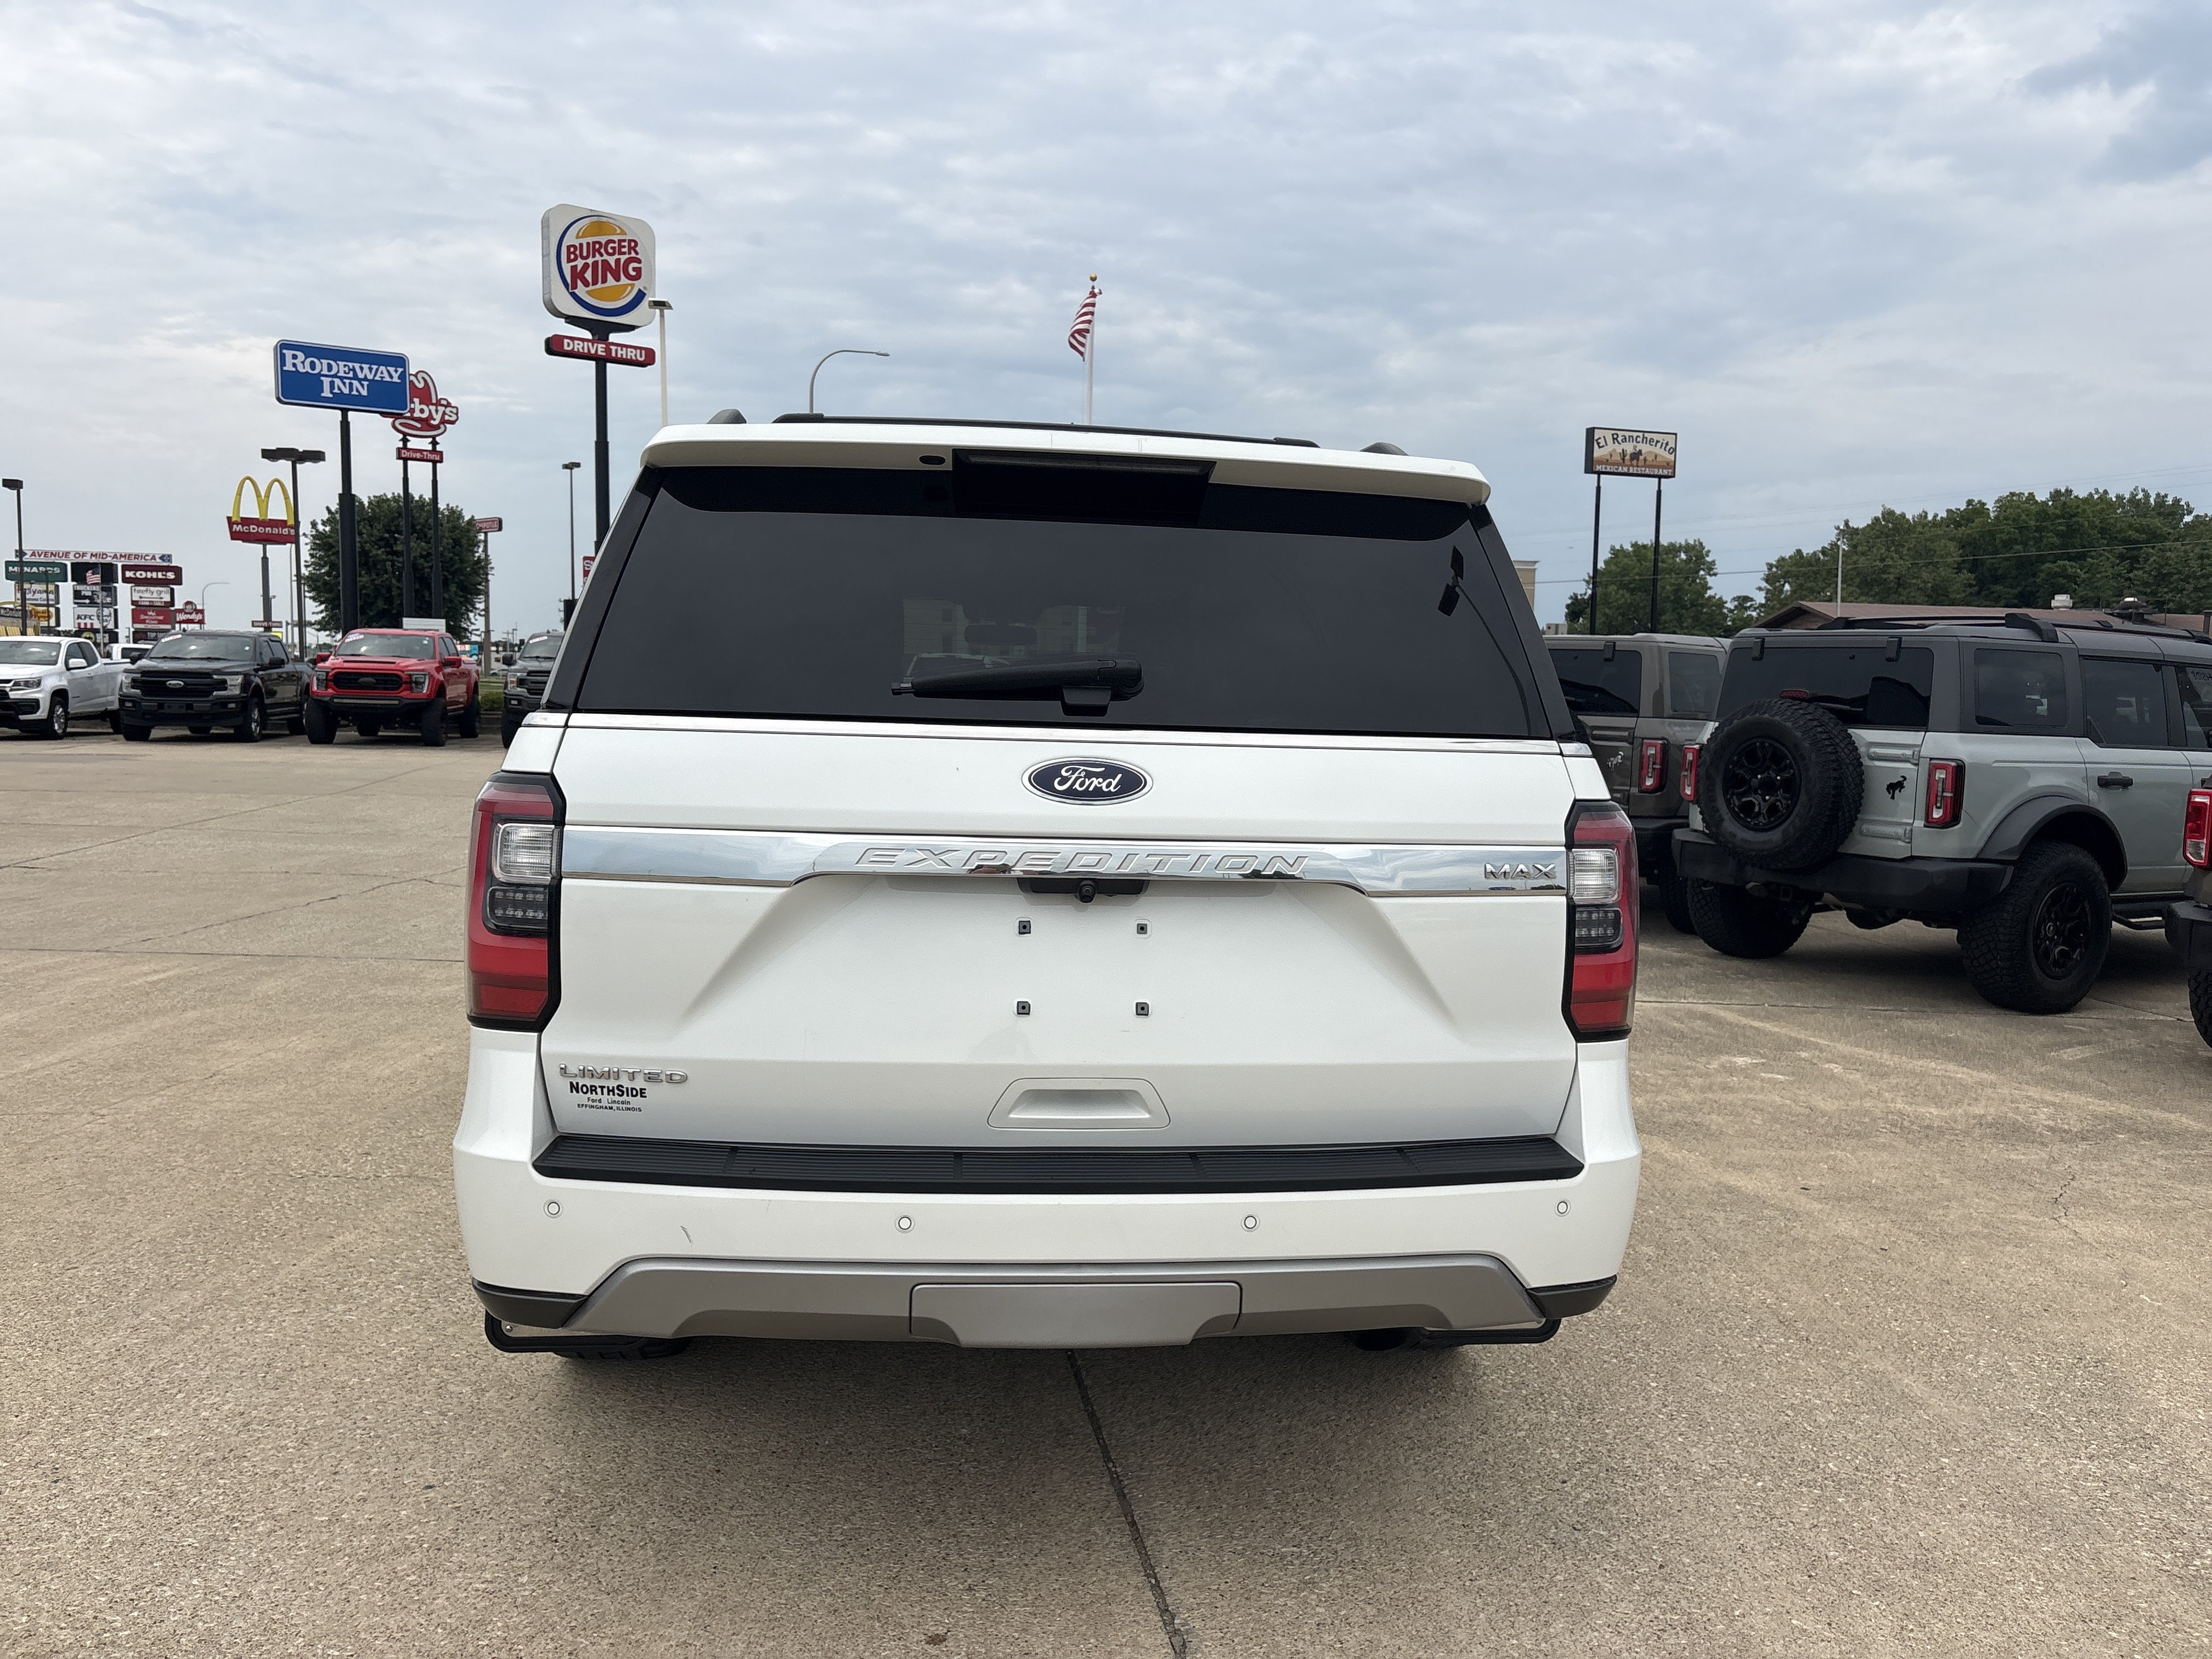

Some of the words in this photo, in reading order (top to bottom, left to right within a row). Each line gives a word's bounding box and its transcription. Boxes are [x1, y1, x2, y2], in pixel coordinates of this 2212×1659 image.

[566, 239, 639, 264] BURGER
[570, 256, 642, 291] KING
[563, 339, 606, 356] DRIVE
[610, 345, 646, 361] THRU
[282, 349, 404, 383] RODEWAY
[320, 376, 369, 398] INN
[1595, 435, 1608, 449] El
[1611, 432, 1675, 455] Rancherito
[401, 450, 440, 460] Drive-Thru
[1596, 465, 1628, 473] MEXICAN
[1629, 467, 1673, 476] RESTAURANT
[232, 524, 295, 535] McDonald's
[89, 552, 157, 561] MID-AMERICA
[125, 570, 176, 579] KOHL'S
[176, 612, 202, 622] Wendy's
[1054, 765, 1122, 792] Ford
[854, 847, 1311, 875] EXPEDITION
[1484, 863, 1557, 879] MAX
[559, 1064, 689, 1084] LIMITED
[577, 1103, 616, 1111] EFFINGHAM,
